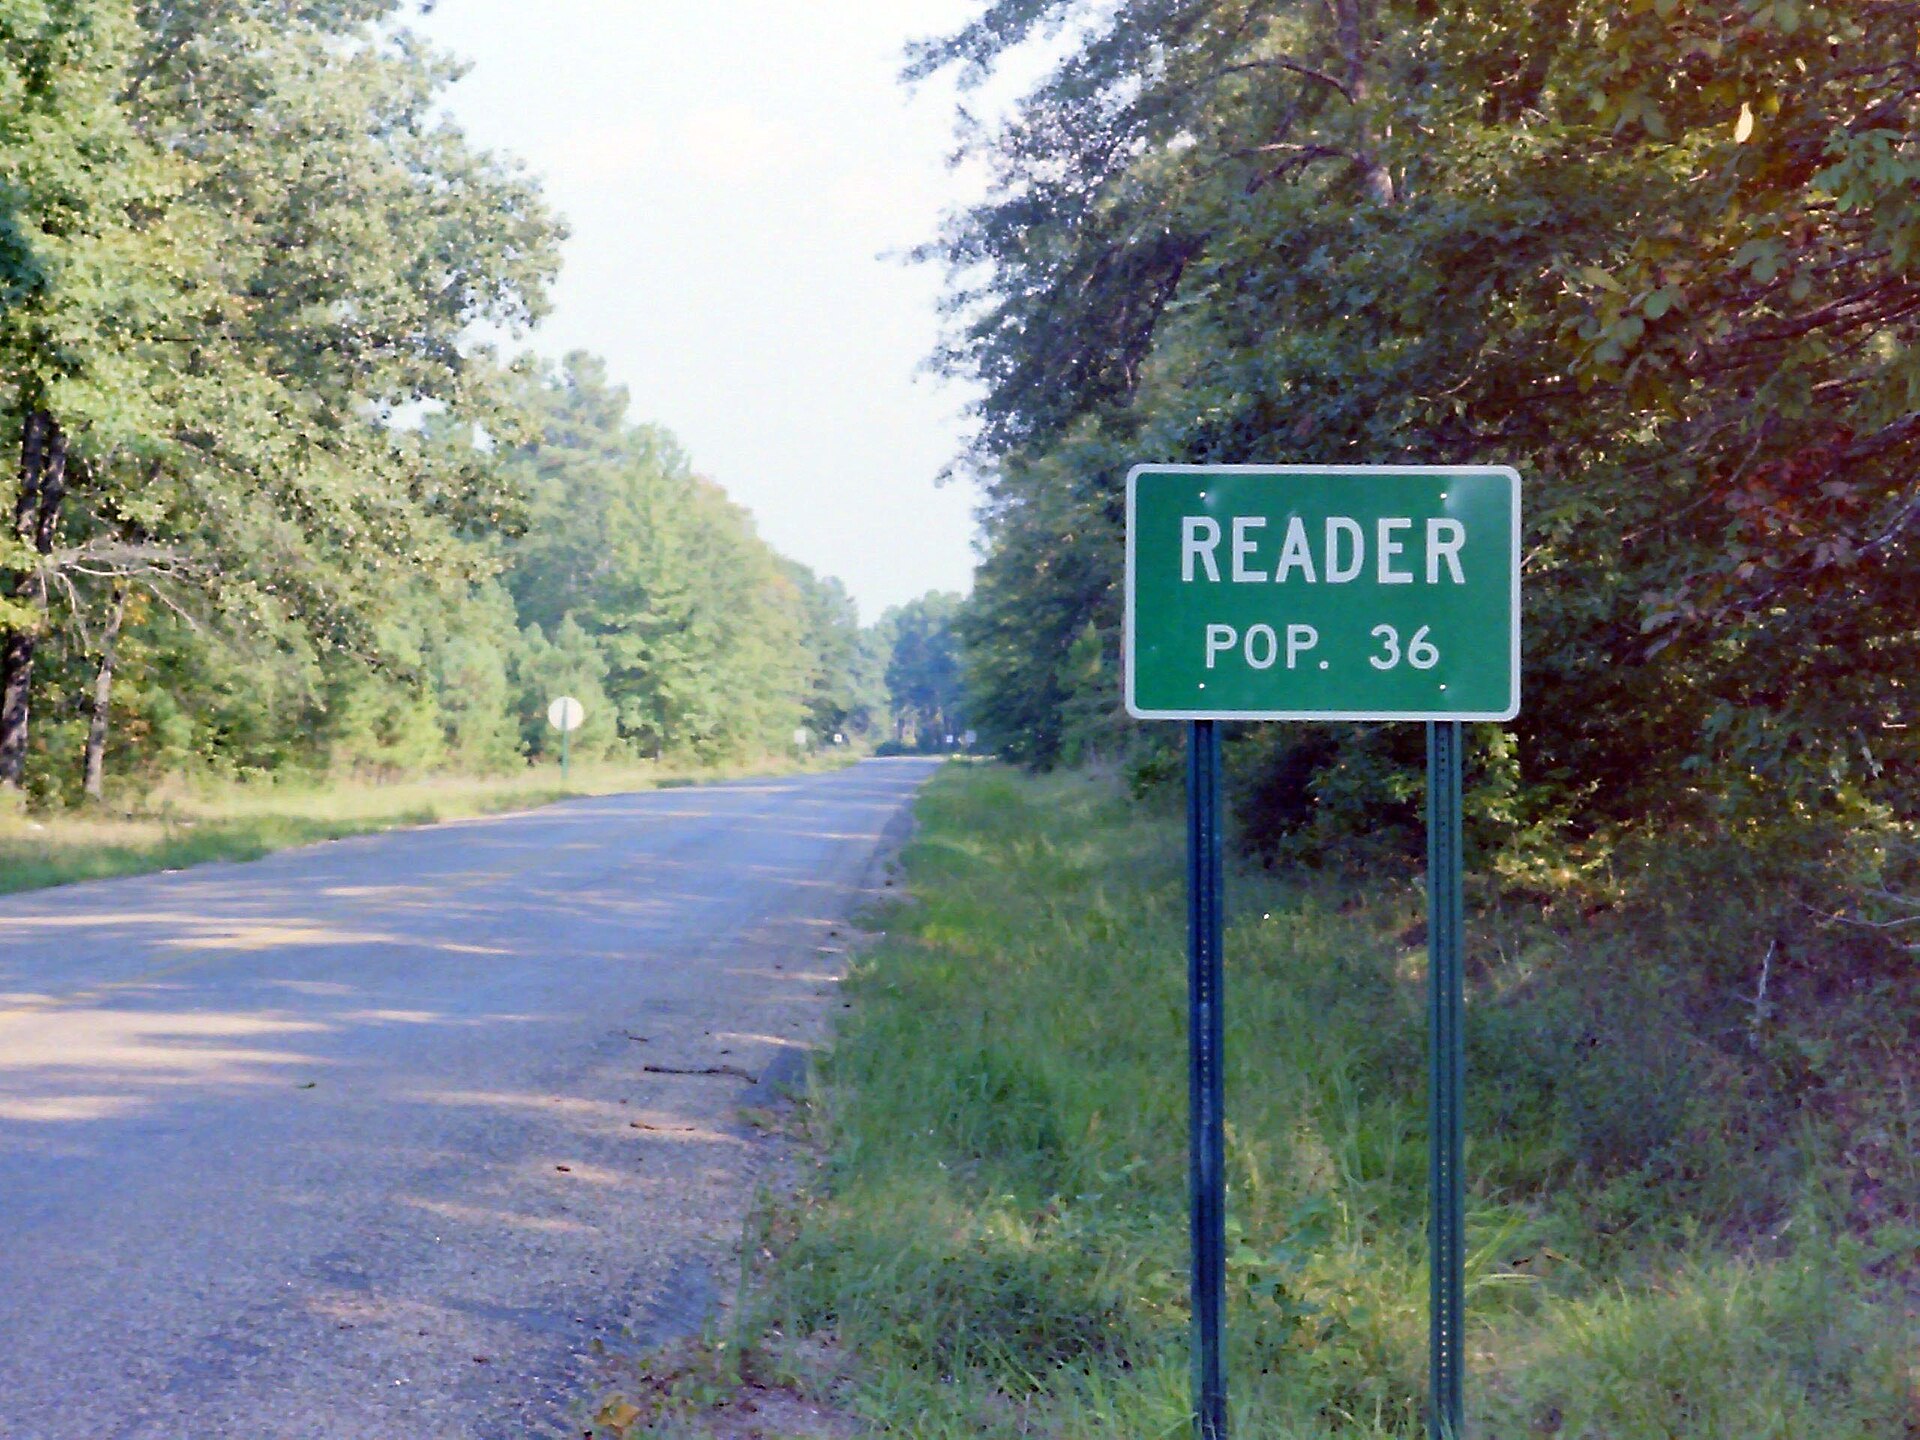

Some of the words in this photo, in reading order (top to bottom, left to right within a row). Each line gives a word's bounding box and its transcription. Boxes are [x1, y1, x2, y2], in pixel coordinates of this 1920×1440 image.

[1181, 515, 1467, 585] READER
[1205, 622, 1330, 671] POP.
[1368, 623, 1440, 671] 36
